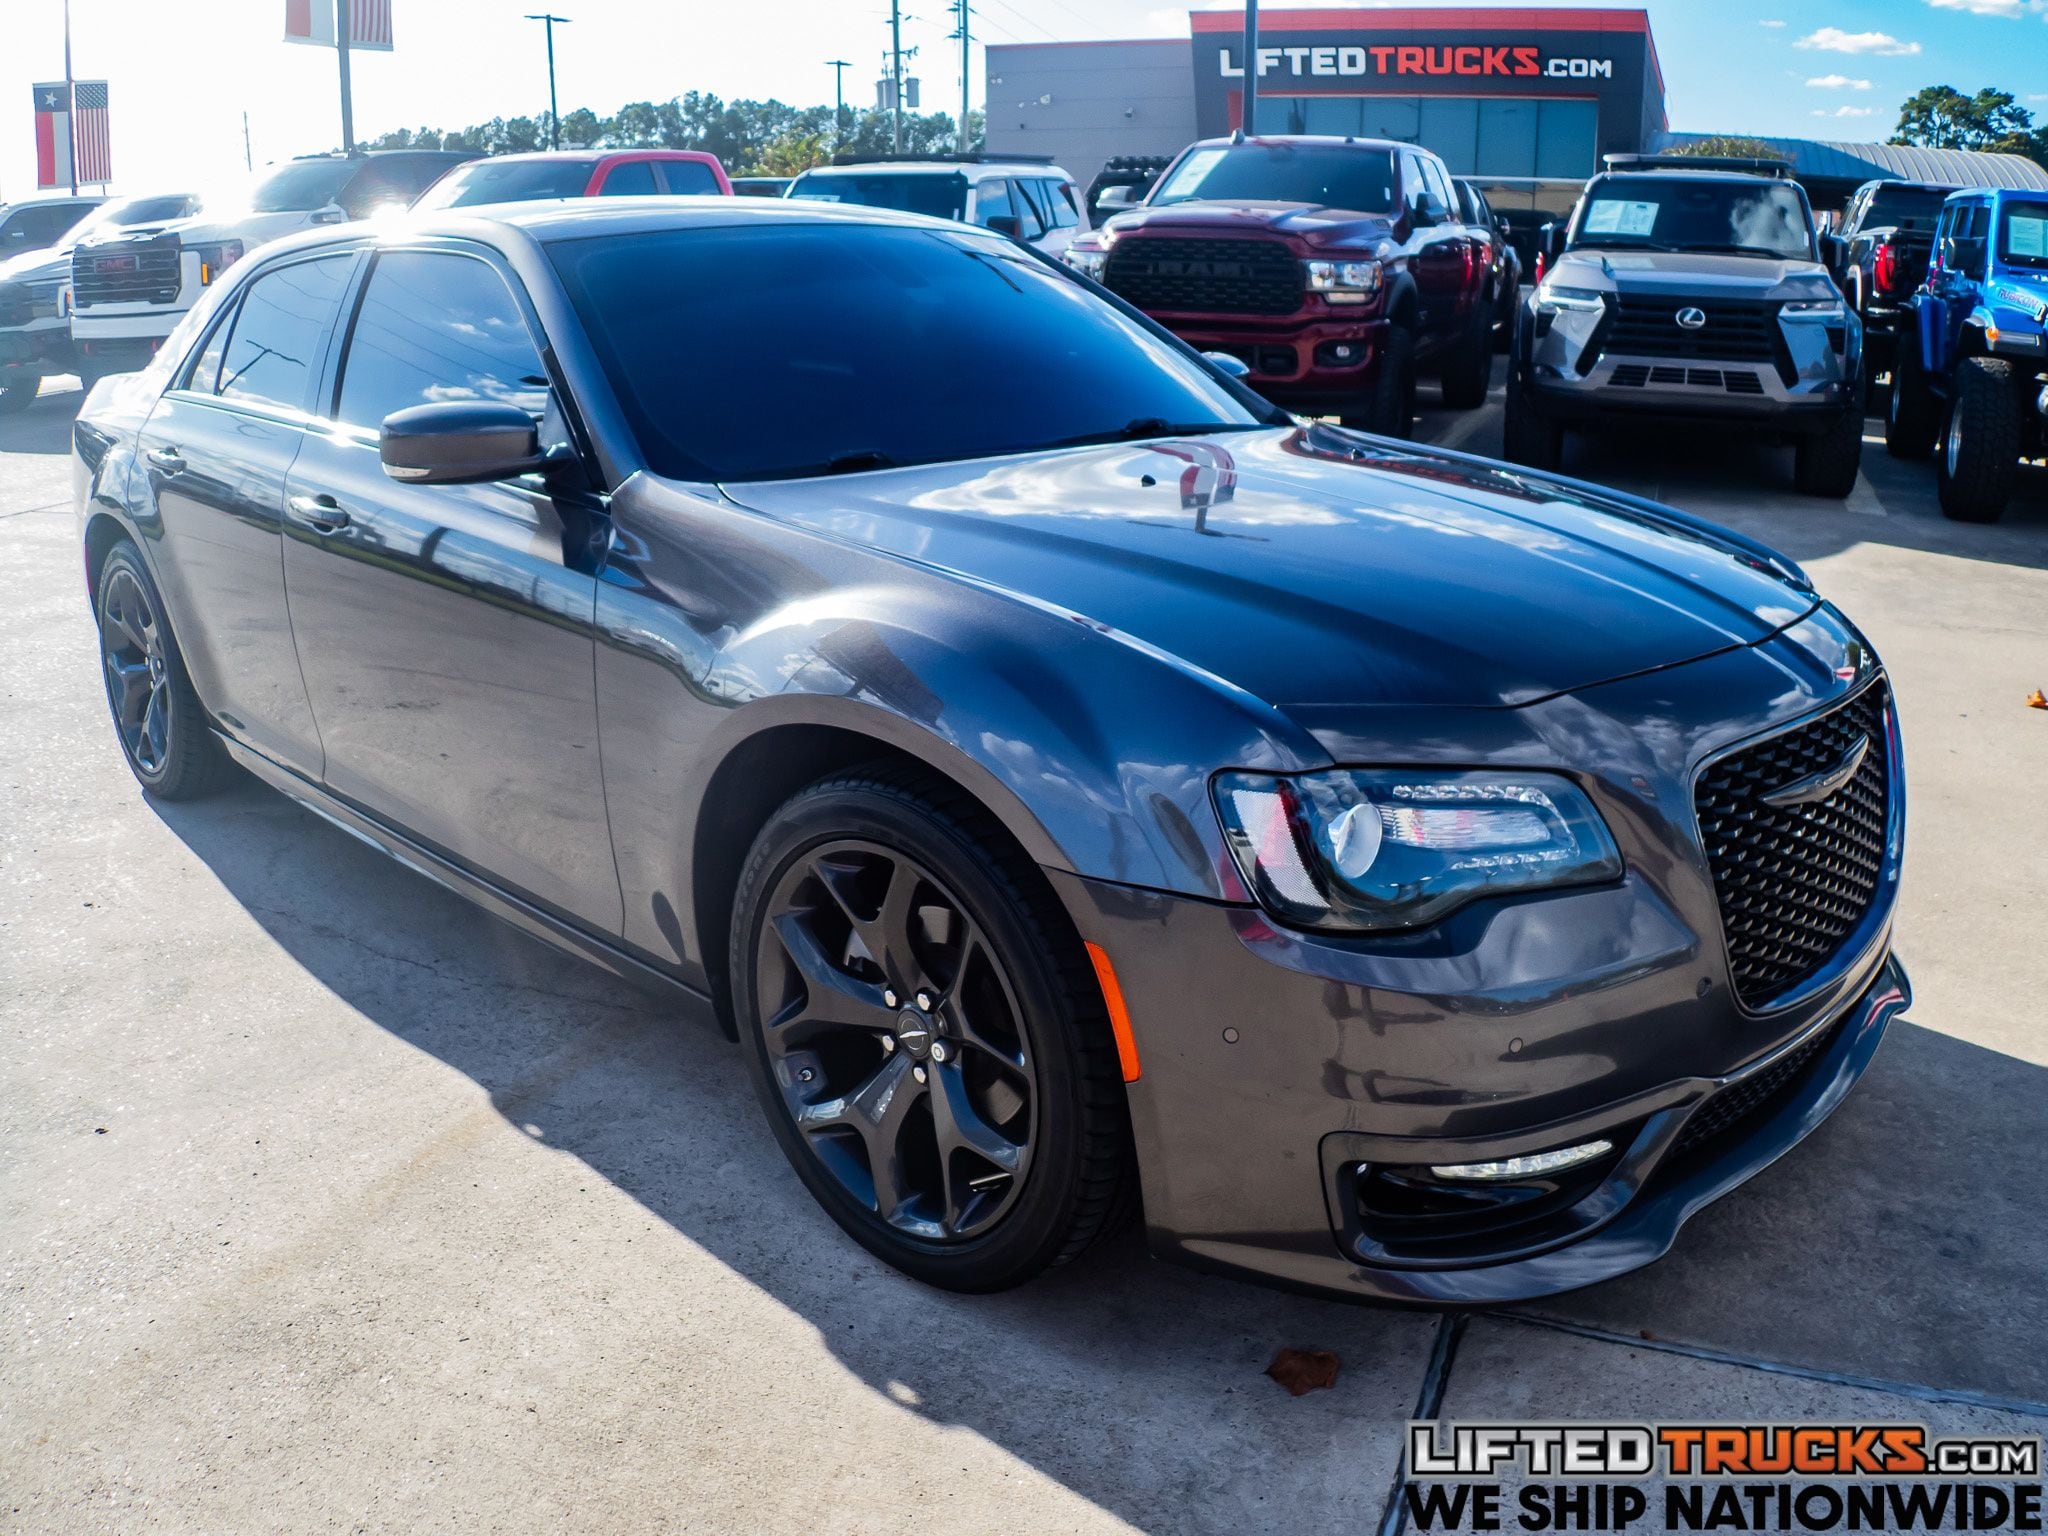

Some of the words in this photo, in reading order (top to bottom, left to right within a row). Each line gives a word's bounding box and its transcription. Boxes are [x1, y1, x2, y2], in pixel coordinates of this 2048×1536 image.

[1219, 47, 1612, 78] LFTEDTRUCKS.COM
[96, 258, 135, 272] GMC
[1998, 288, 2039, 309] RUBICON
